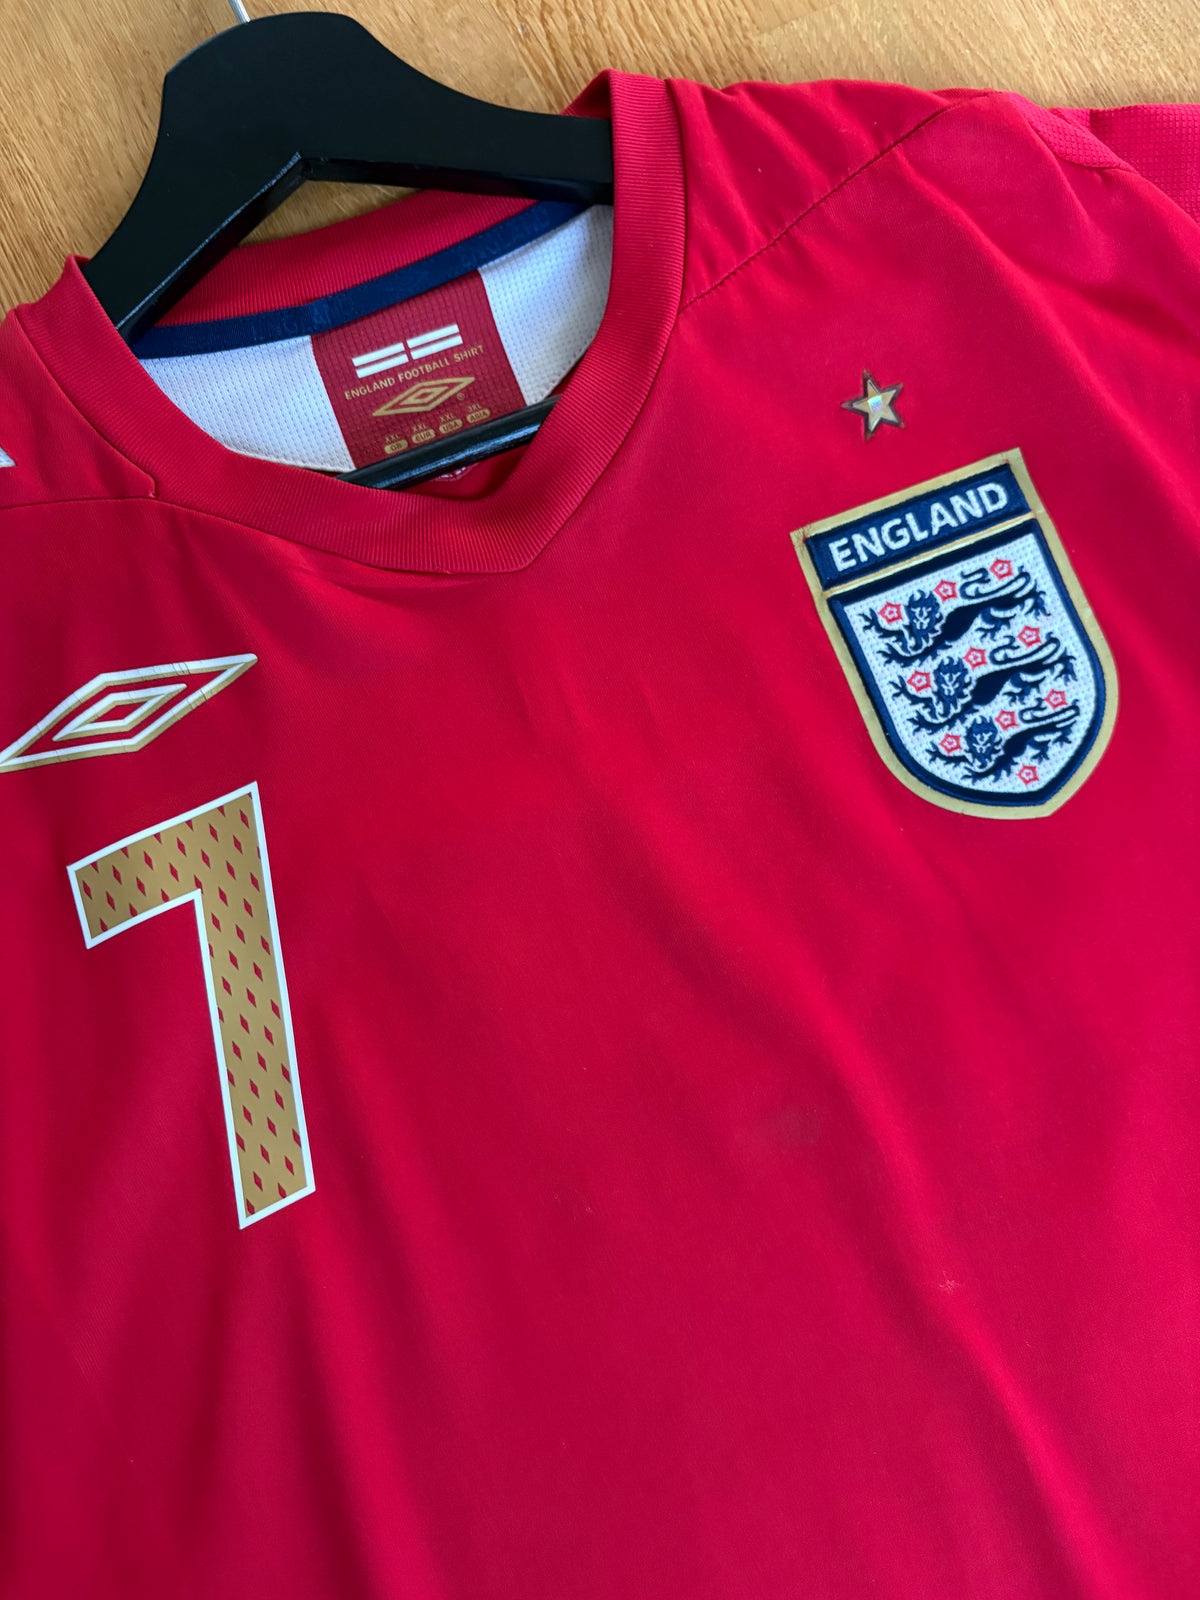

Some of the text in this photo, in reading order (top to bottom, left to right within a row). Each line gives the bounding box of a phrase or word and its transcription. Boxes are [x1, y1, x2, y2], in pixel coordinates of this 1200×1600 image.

[344, 345, 485, 400] ENGLAND FOOTBALL SHIRT
[385, 433, 401, 442] XXL
[412, 424, 428, 433] XXL
[440, 414, 455, 423] XXL
[414, 431, 432, 442] EUR
[443, 421, 460, 432] USA
[828, 482, 1009, 572] ENGLAND
[67, 781, 316, 1230] 7
